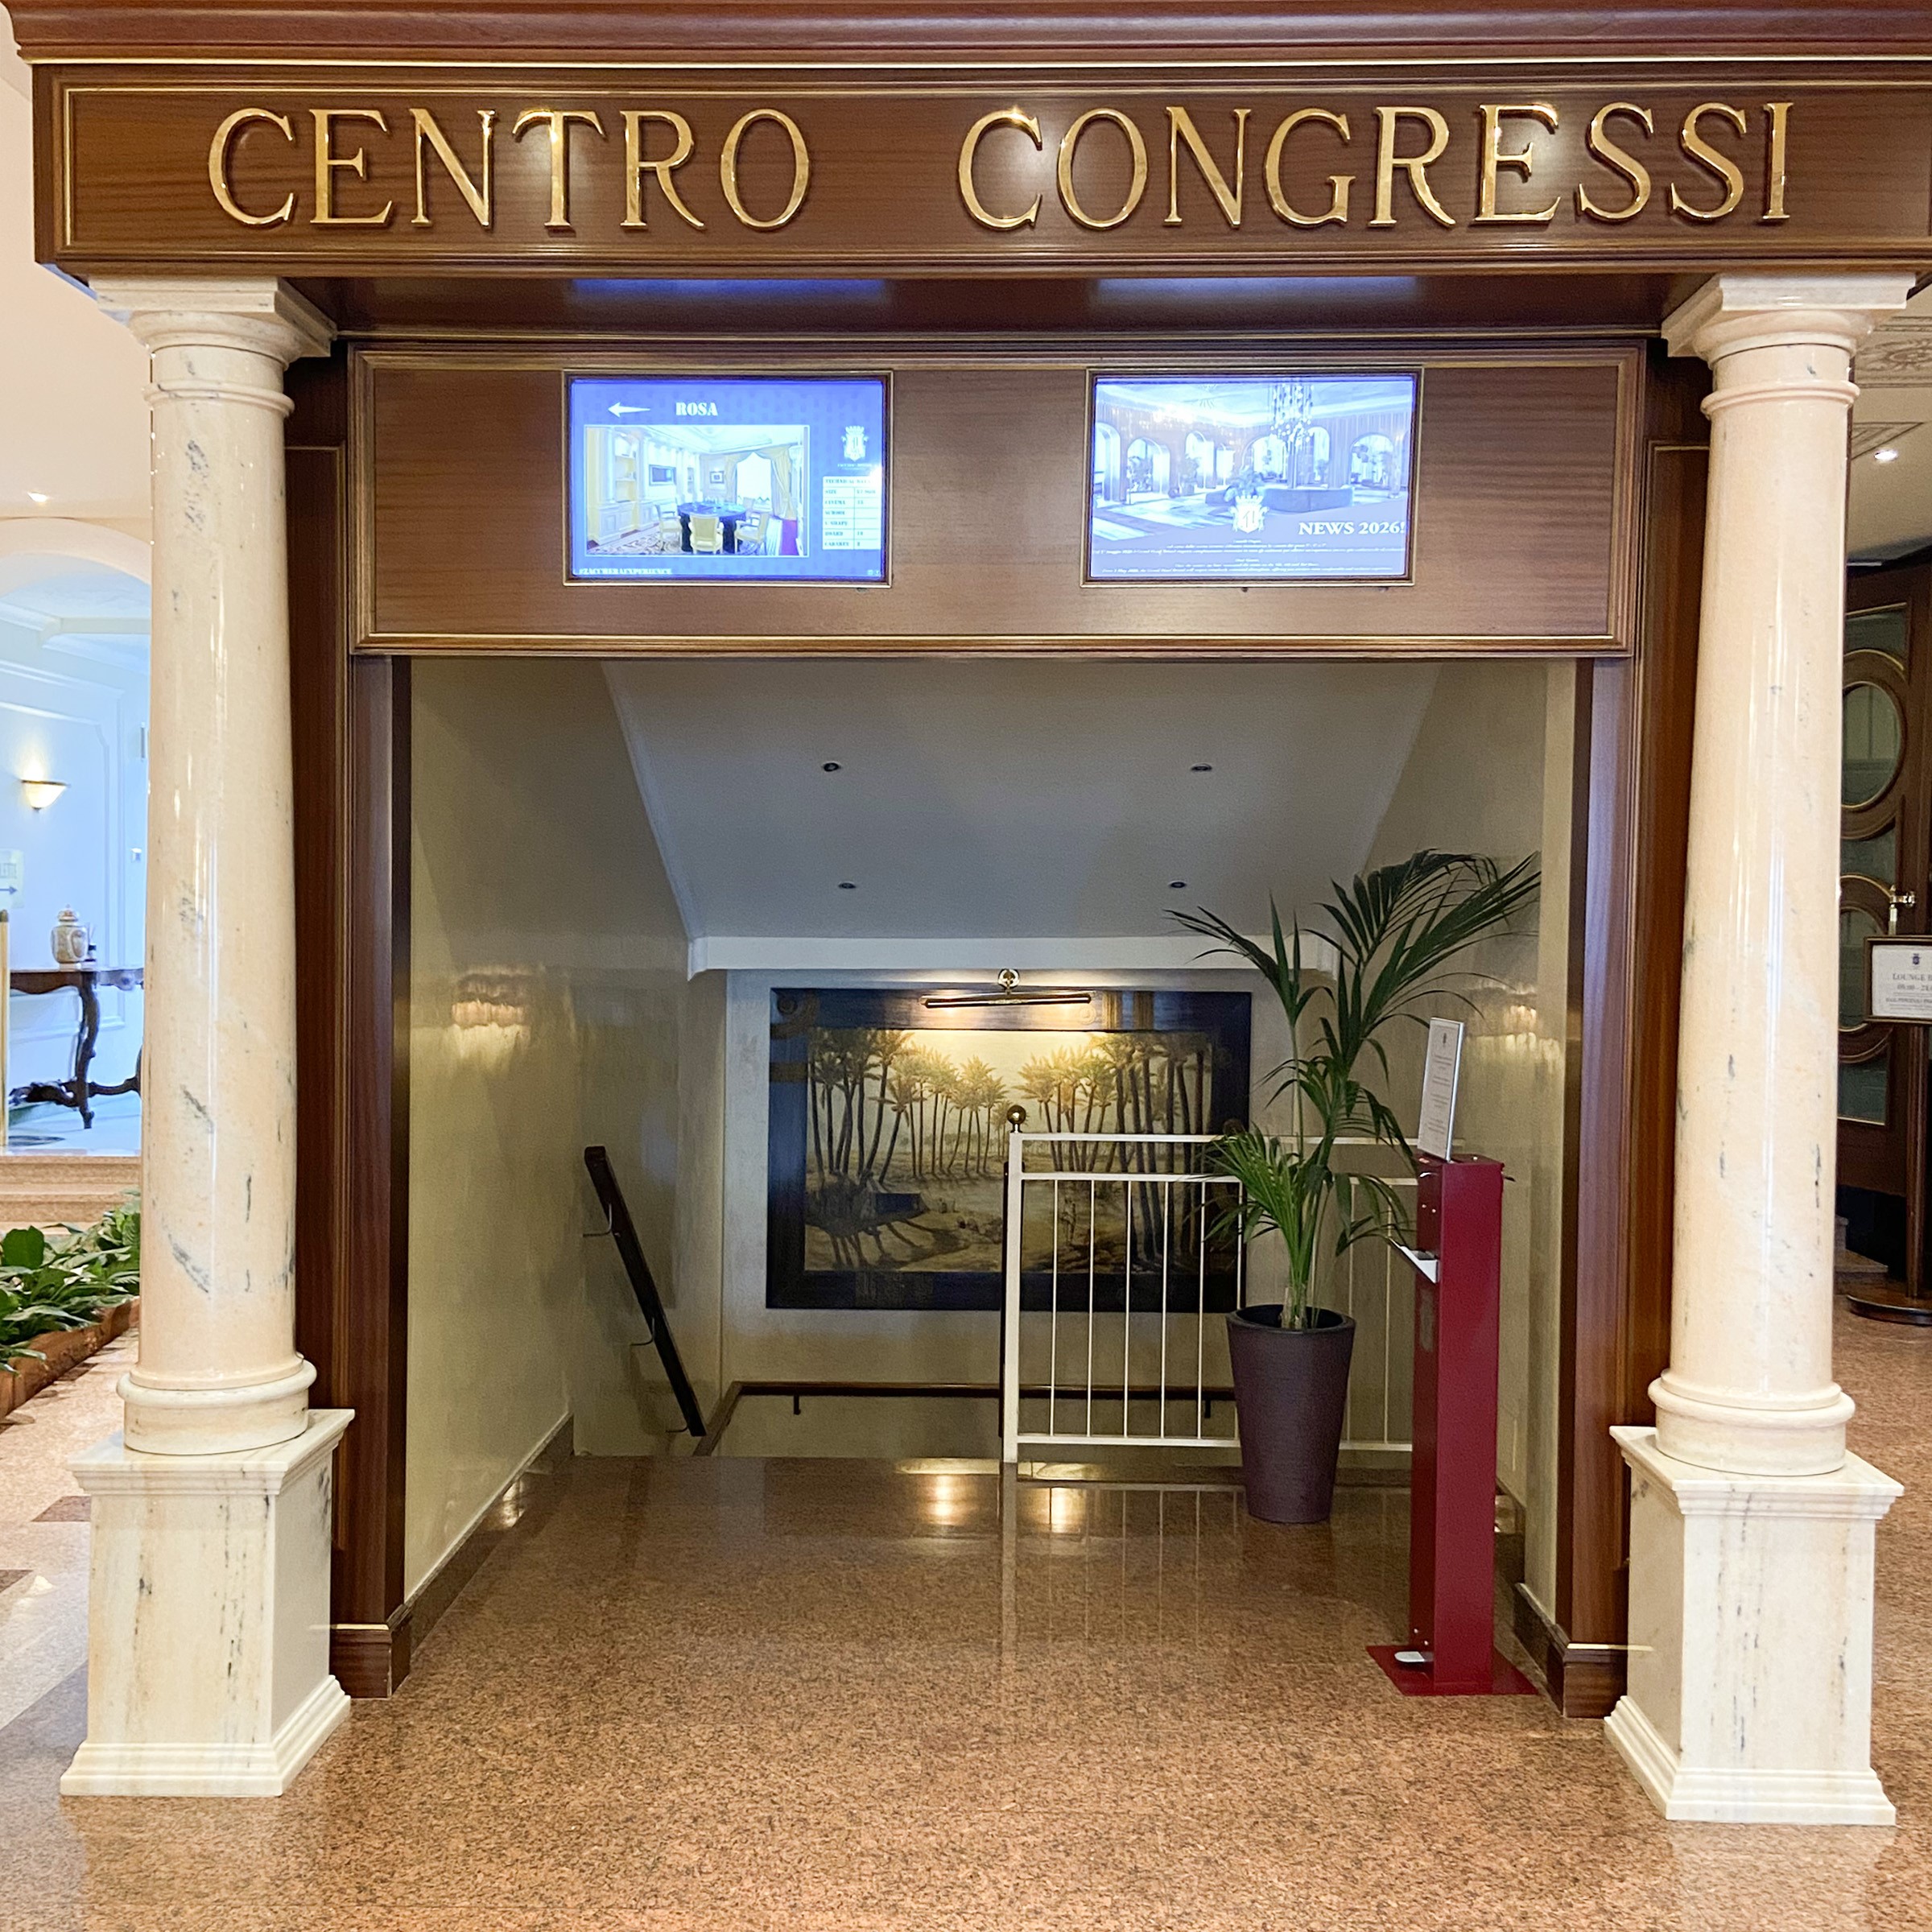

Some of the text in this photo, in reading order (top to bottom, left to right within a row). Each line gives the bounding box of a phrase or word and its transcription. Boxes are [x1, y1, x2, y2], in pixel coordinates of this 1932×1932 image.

[208, 100, 1794, 230] CENTRO CONGRESSI
[675, 402, 718, 416] ROSA
[1298, 521, 1406, 535] NEWS 2026!
